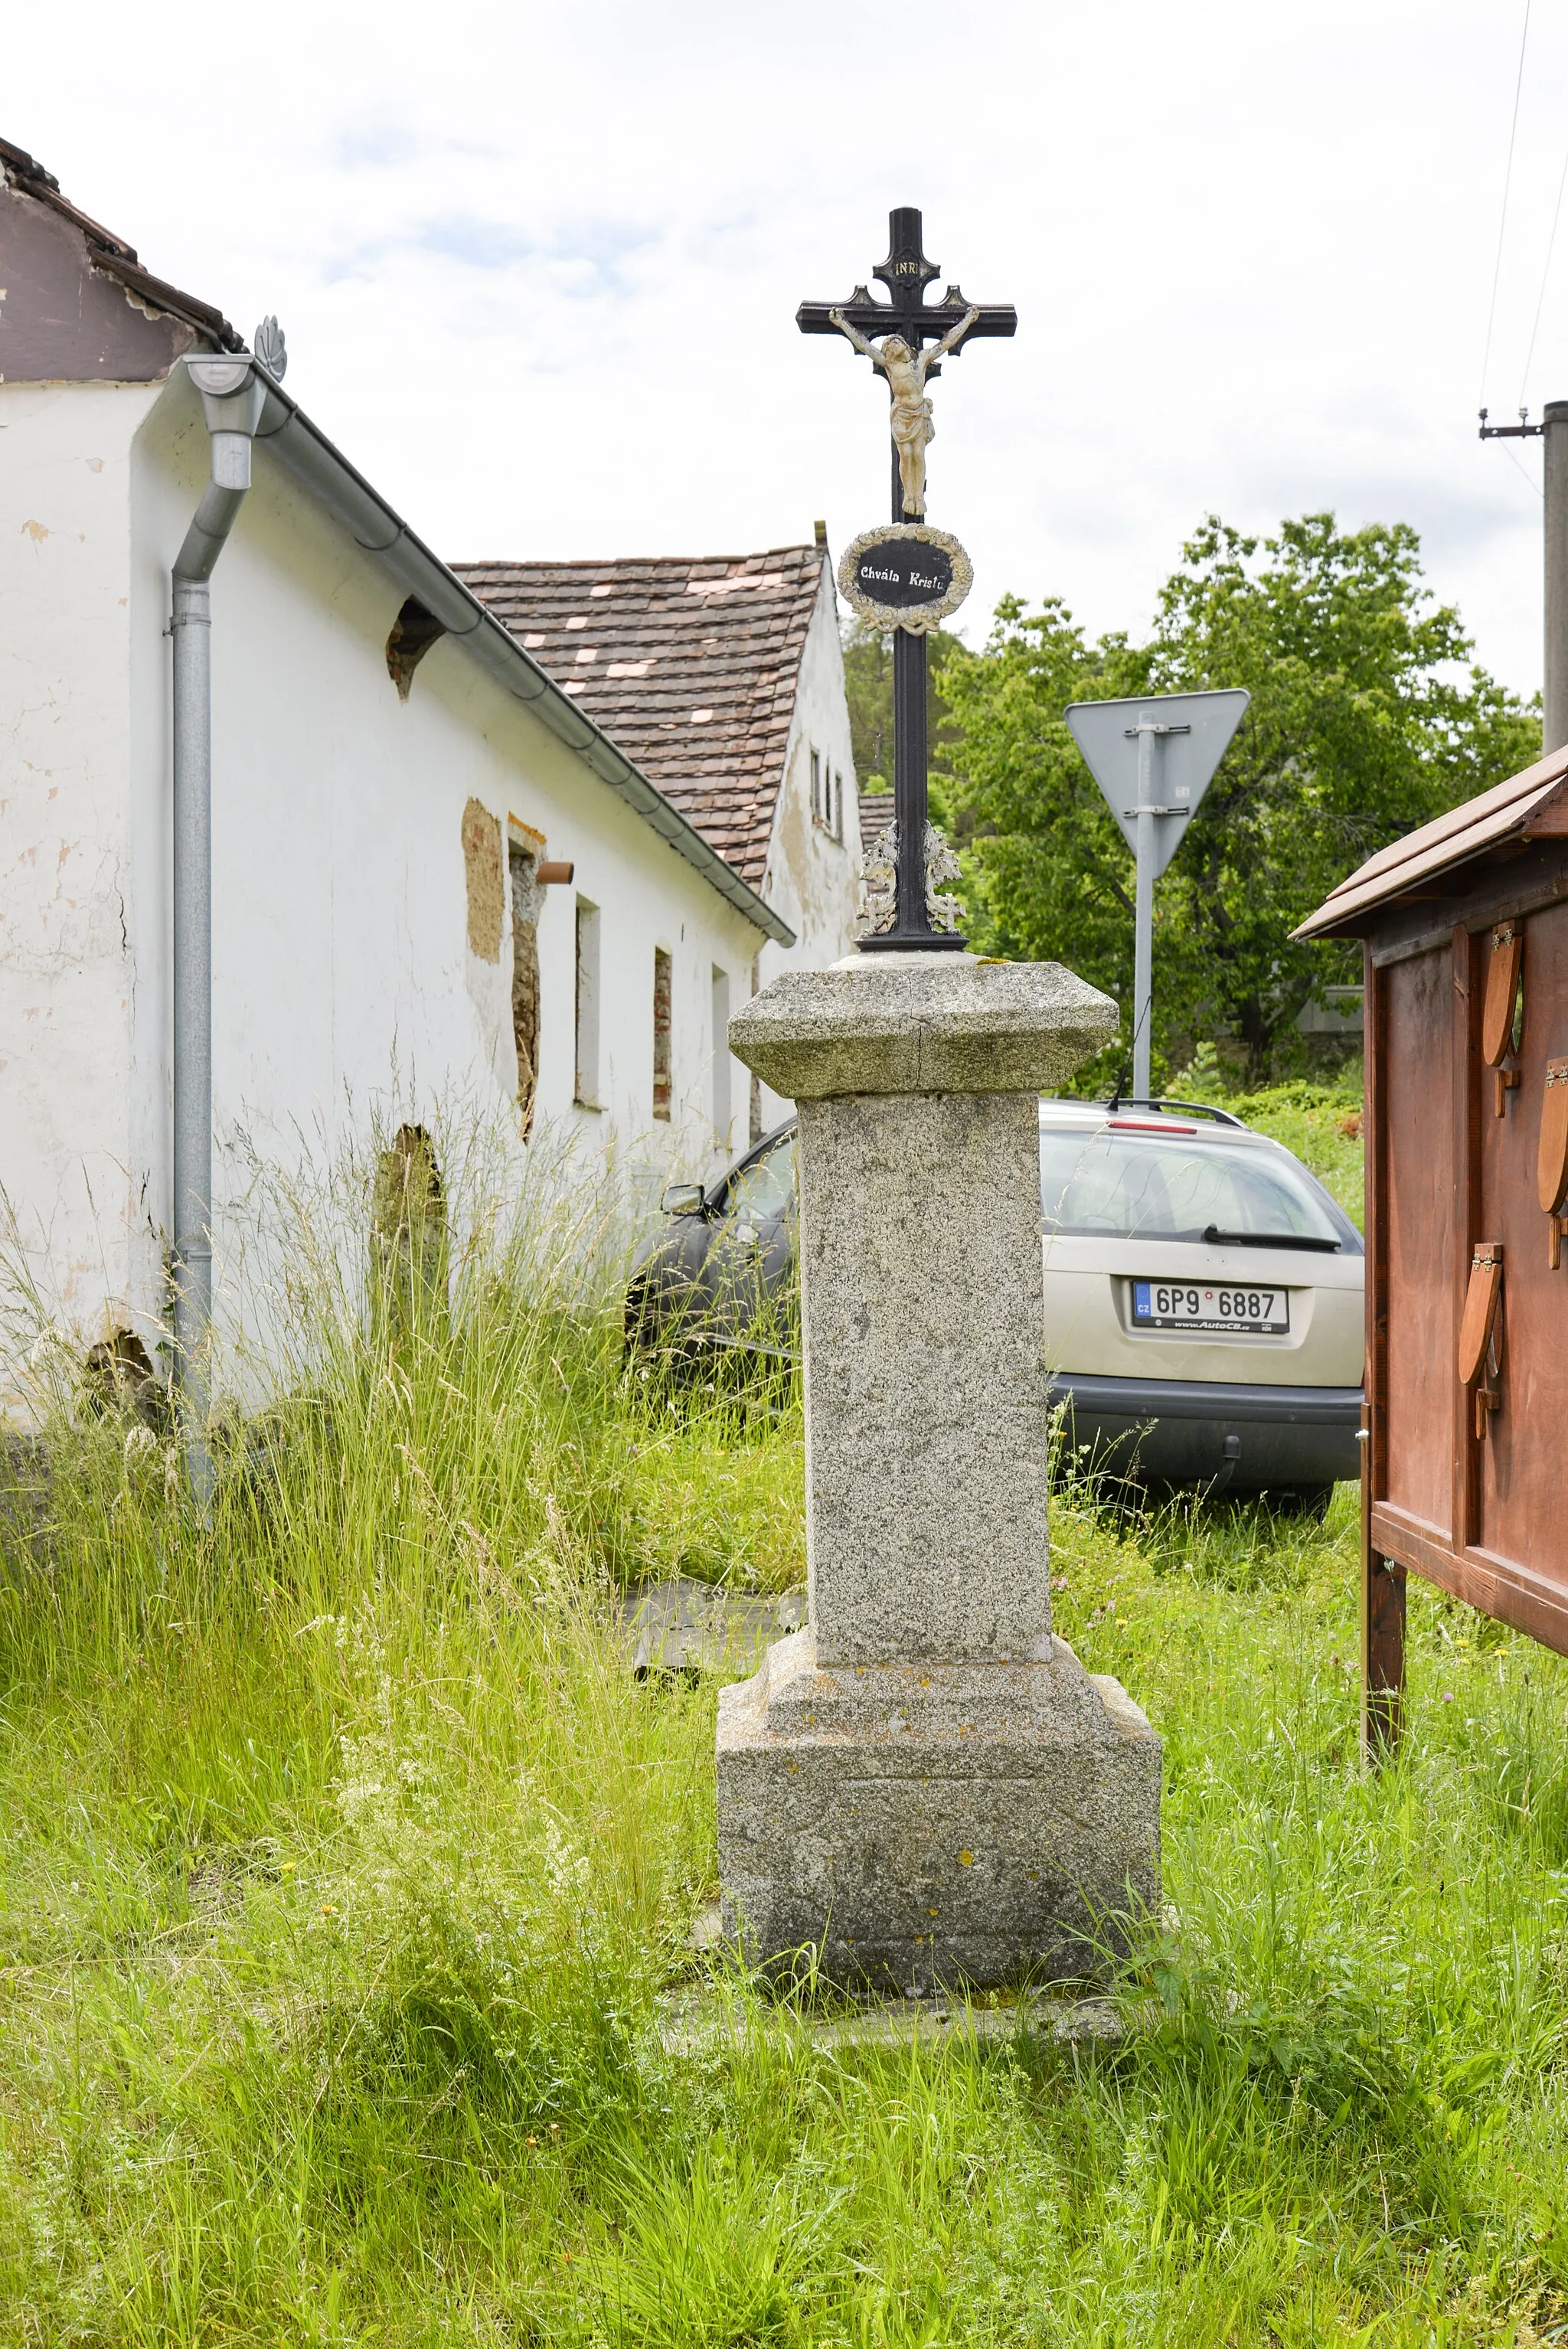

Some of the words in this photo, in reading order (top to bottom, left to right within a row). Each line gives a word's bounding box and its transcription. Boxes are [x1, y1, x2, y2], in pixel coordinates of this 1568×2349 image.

[895, 262, 918, 276] INRI
[861, 566, 900, 583] Chvála
[1138, 1305, 1150, 1313] CZ
[1156, 1288, 1199, 1315] 6P9
[1219, 1292, 1275, 1318] 6887
[1174, 1322, 1250, 1331] www.AutoCB.cz
